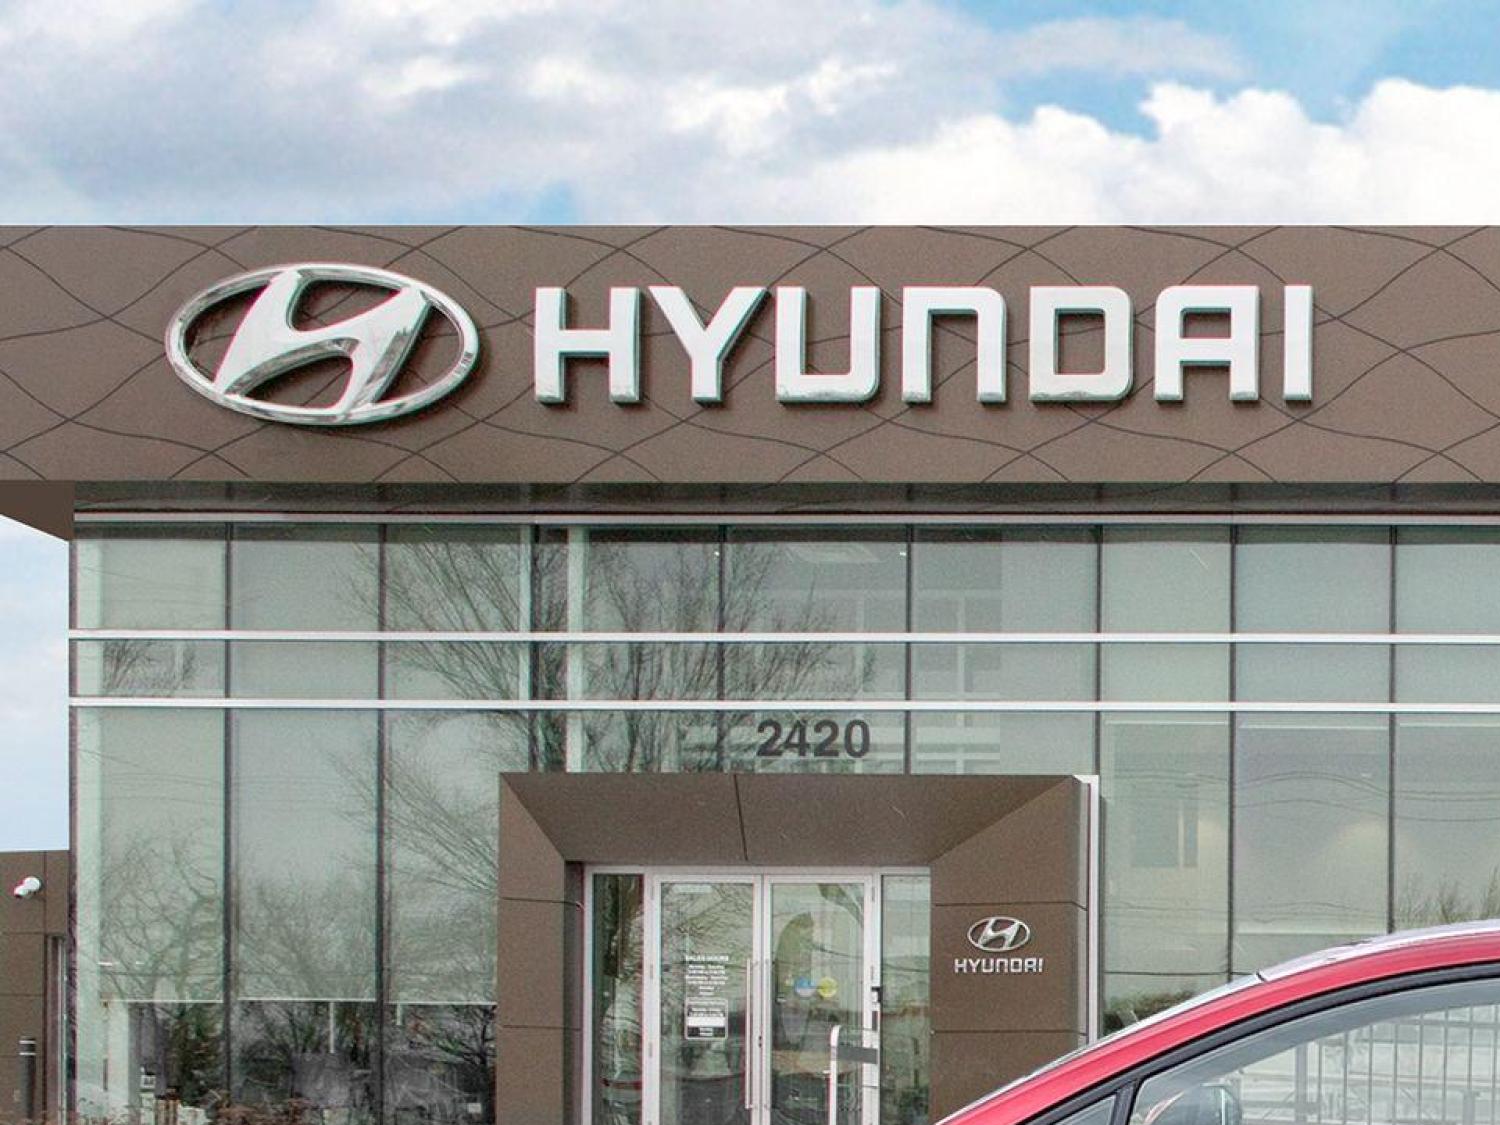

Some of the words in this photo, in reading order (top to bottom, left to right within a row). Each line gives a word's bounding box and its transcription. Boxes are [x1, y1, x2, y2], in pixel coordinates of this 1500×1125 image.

[535, 285, 1314, 402] HYUNDAI
[757, 719, 870, 758] 2420
[954, 958, 1043, 973] HYUNDAI
